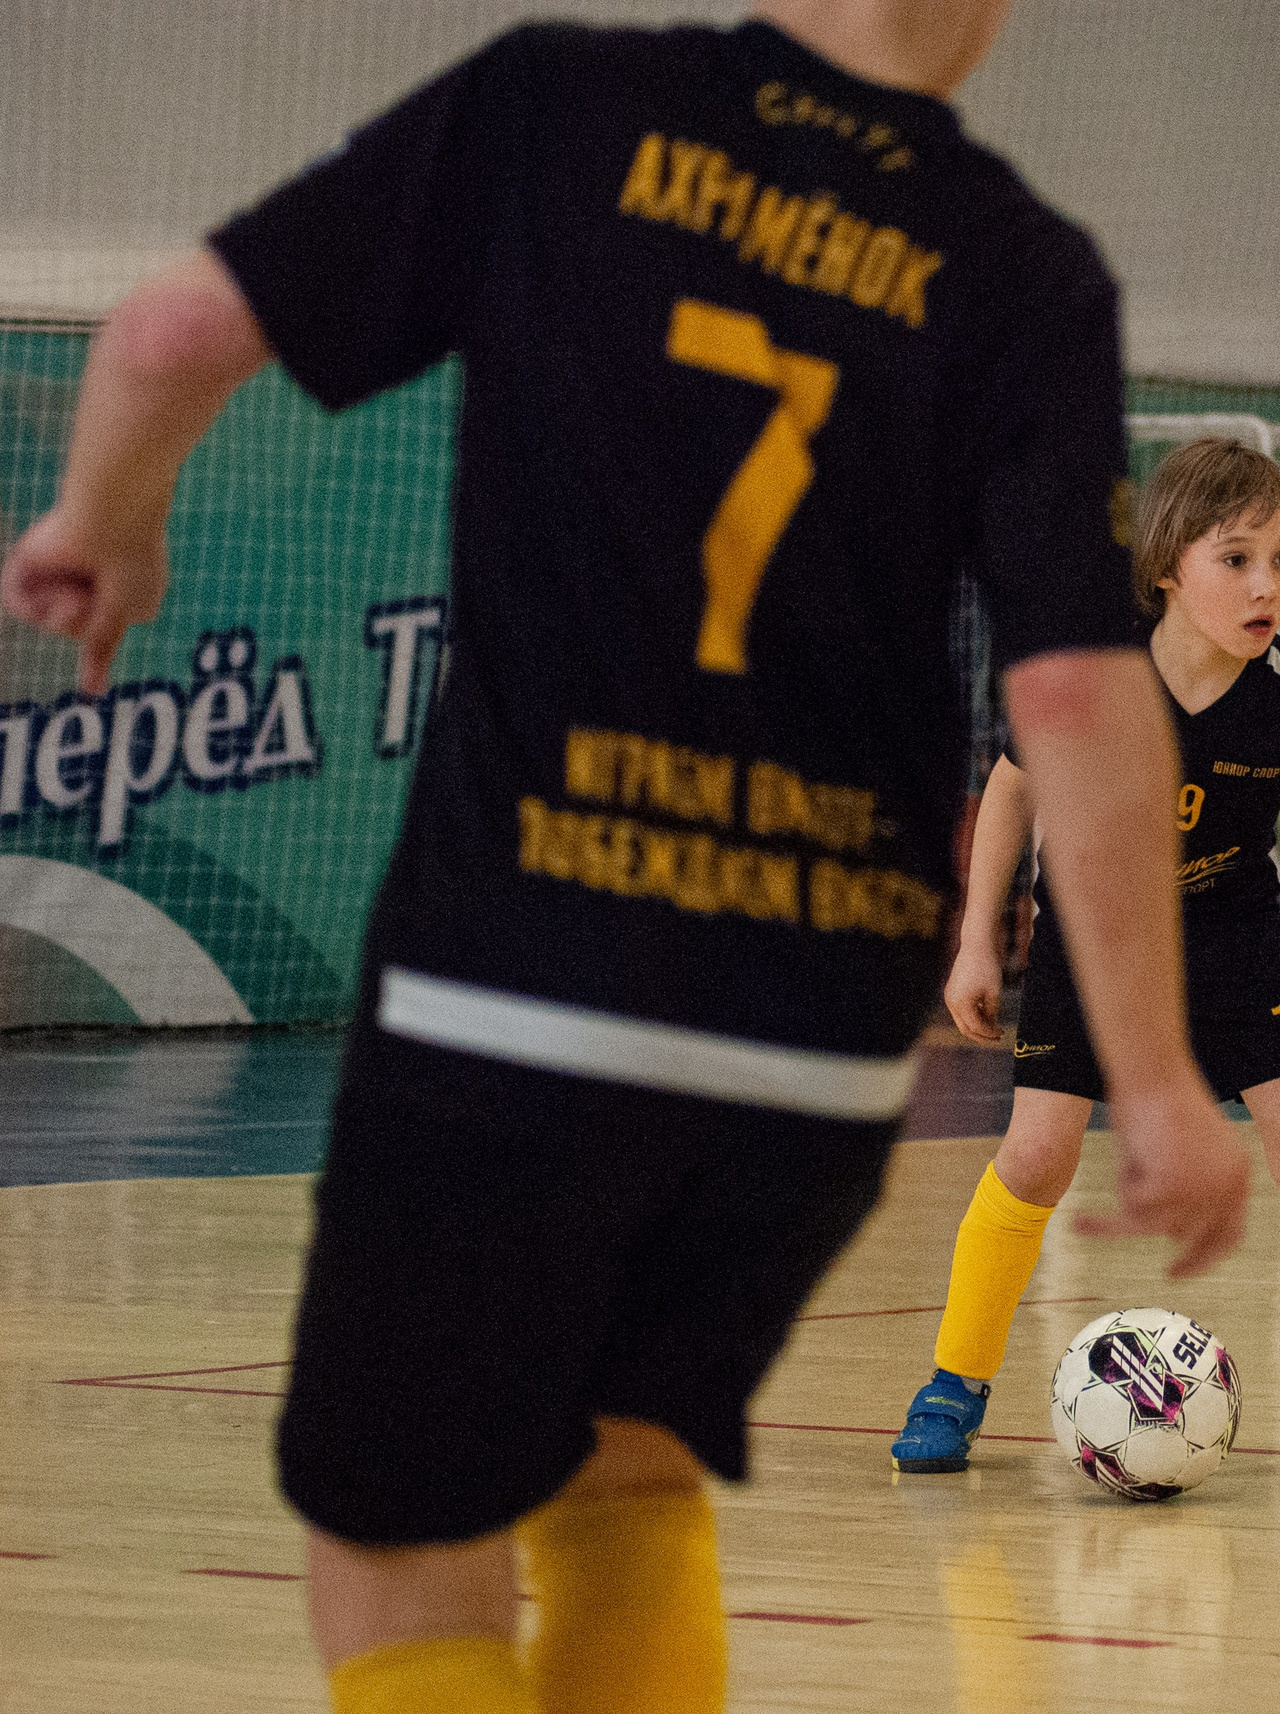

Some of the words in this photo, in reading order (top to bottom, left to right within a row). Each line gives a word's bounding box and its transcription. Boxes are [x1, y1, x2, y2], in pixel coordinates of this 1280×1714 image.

[667, 298, 839, 674] 7
[1212, 760, 1251, 777] ЮНИОР
[1178, 784, 1205, 831] 9
